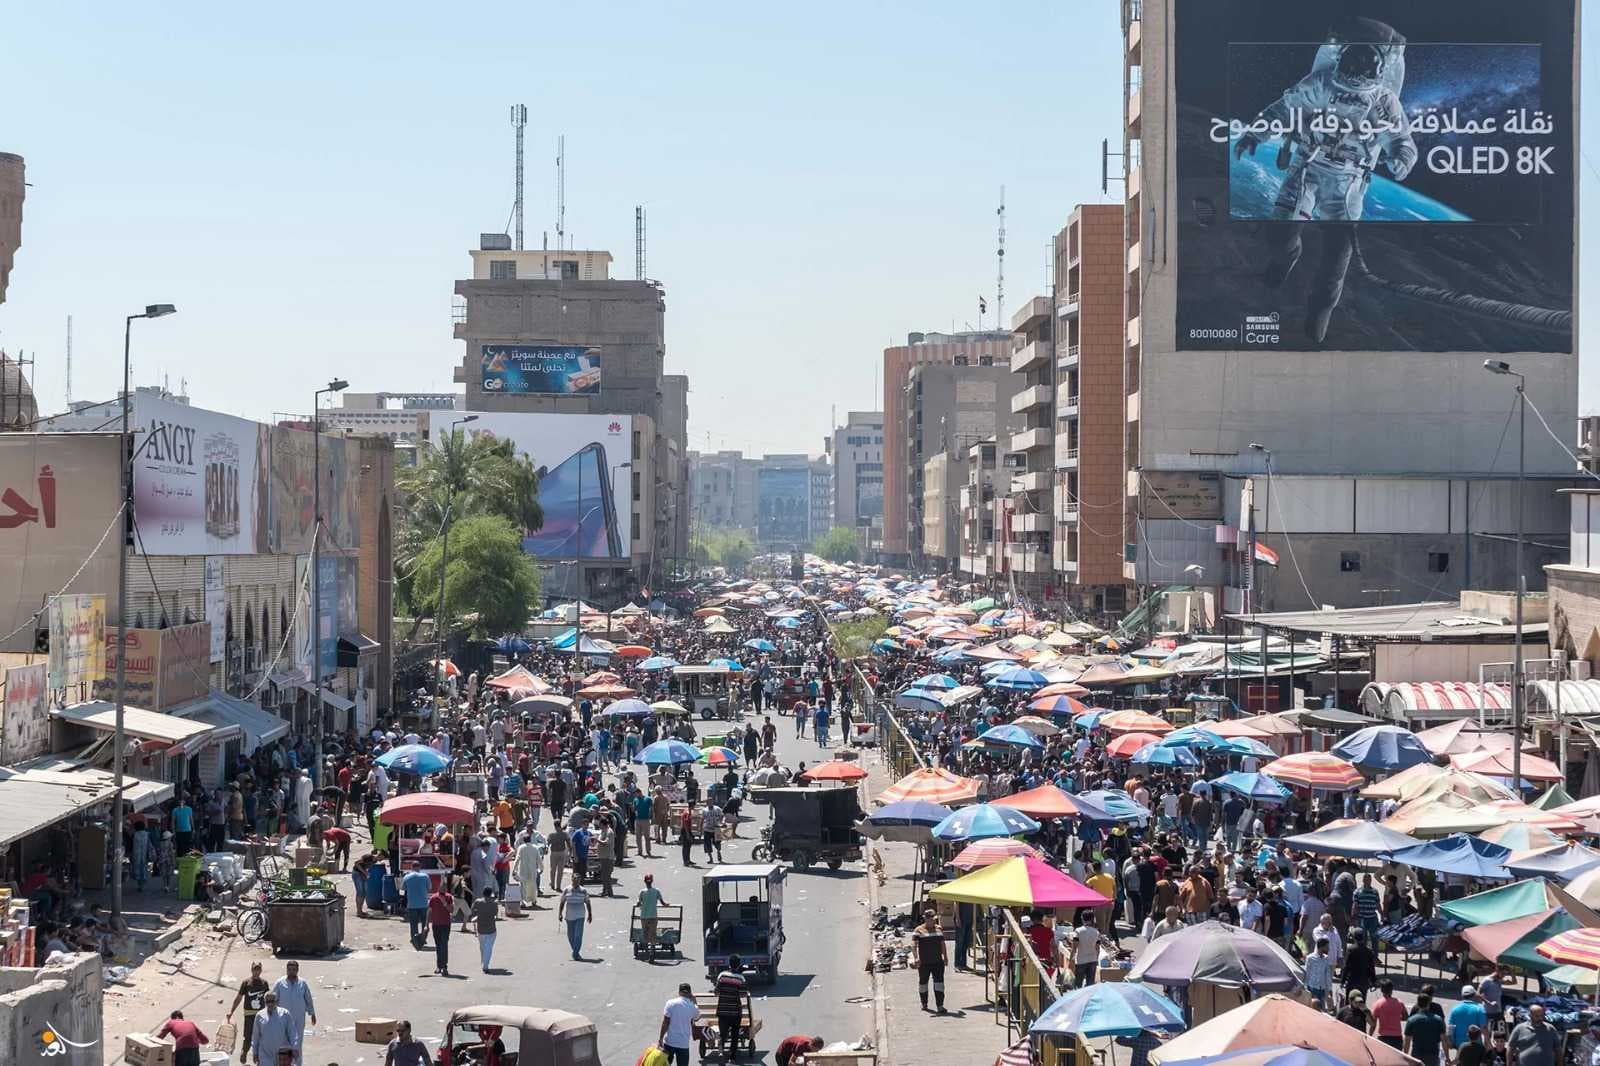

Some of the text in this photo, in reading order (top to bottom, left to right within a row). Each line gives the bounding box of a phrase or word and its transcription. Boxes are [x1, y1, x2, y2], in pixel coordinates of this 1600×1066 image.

[1209, 107, 1553, 143] نقلة عملاقة نحو دقة الوضوح
[1427, 145, 1555, 174] QLED 8K
[1189, 329, 1238, 339] 80010080
[1246, 332, 1280, 344] Care
[145, 419, 196, 466] ANGY
